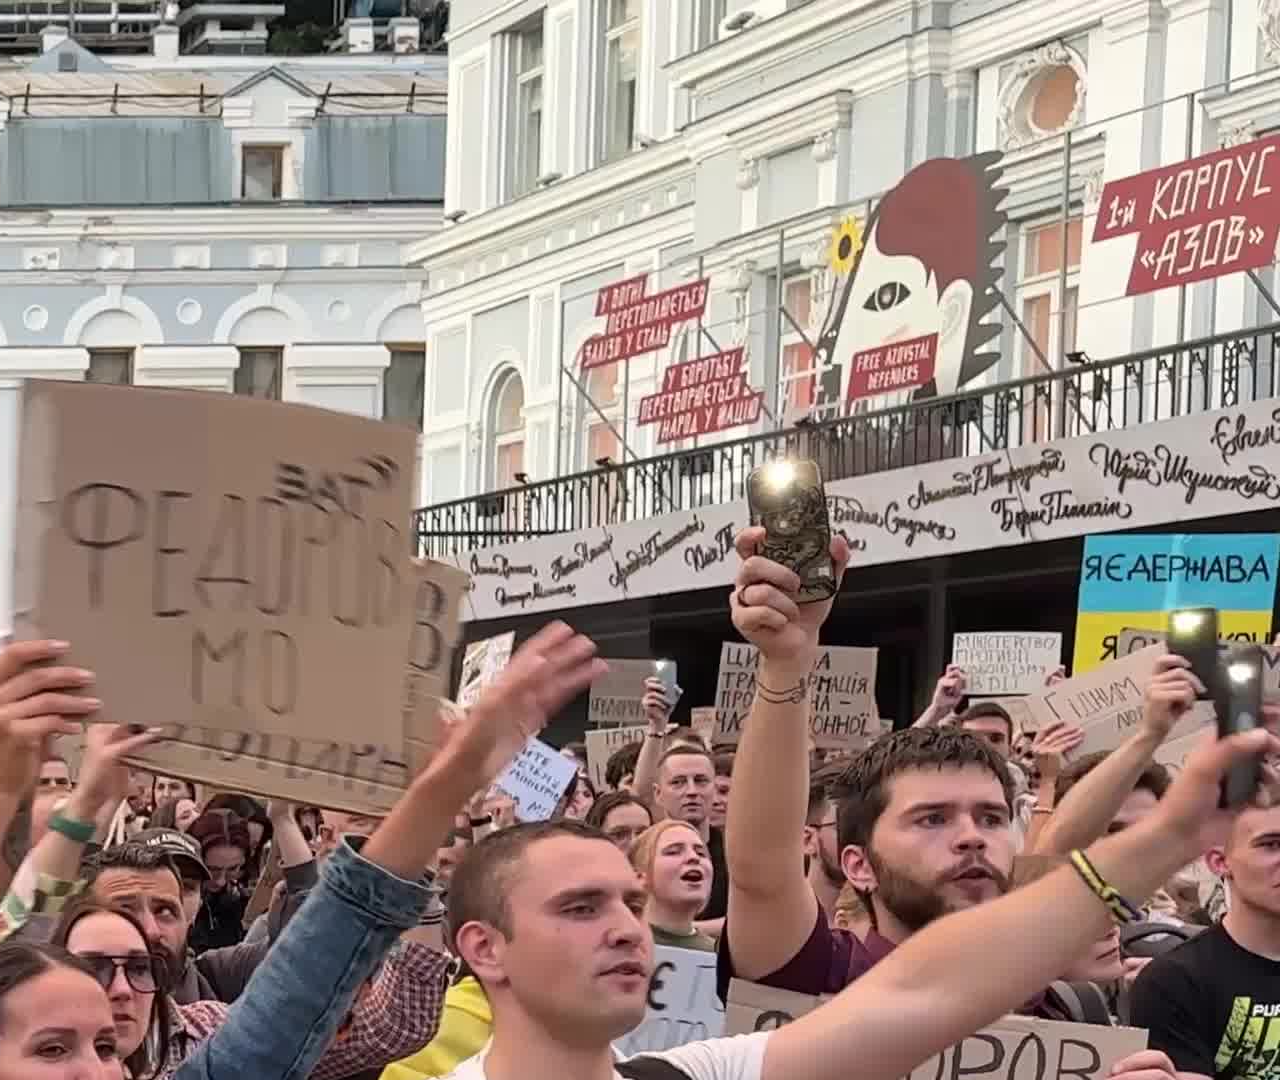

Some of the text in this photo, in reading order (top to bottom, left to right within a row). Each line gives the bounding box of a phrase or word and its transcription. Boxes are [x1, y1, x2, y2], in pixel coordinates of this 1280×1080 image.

[1149, 145, 1275, 224] КОРПУС
[1140, 214, 1265, 281] «АЗОВ»
[856, 340, 932, 372] FREE AZOVSTAL
[867, 364, 920, 390] DEFENDERS
[191, 628, 298, 715] МО
